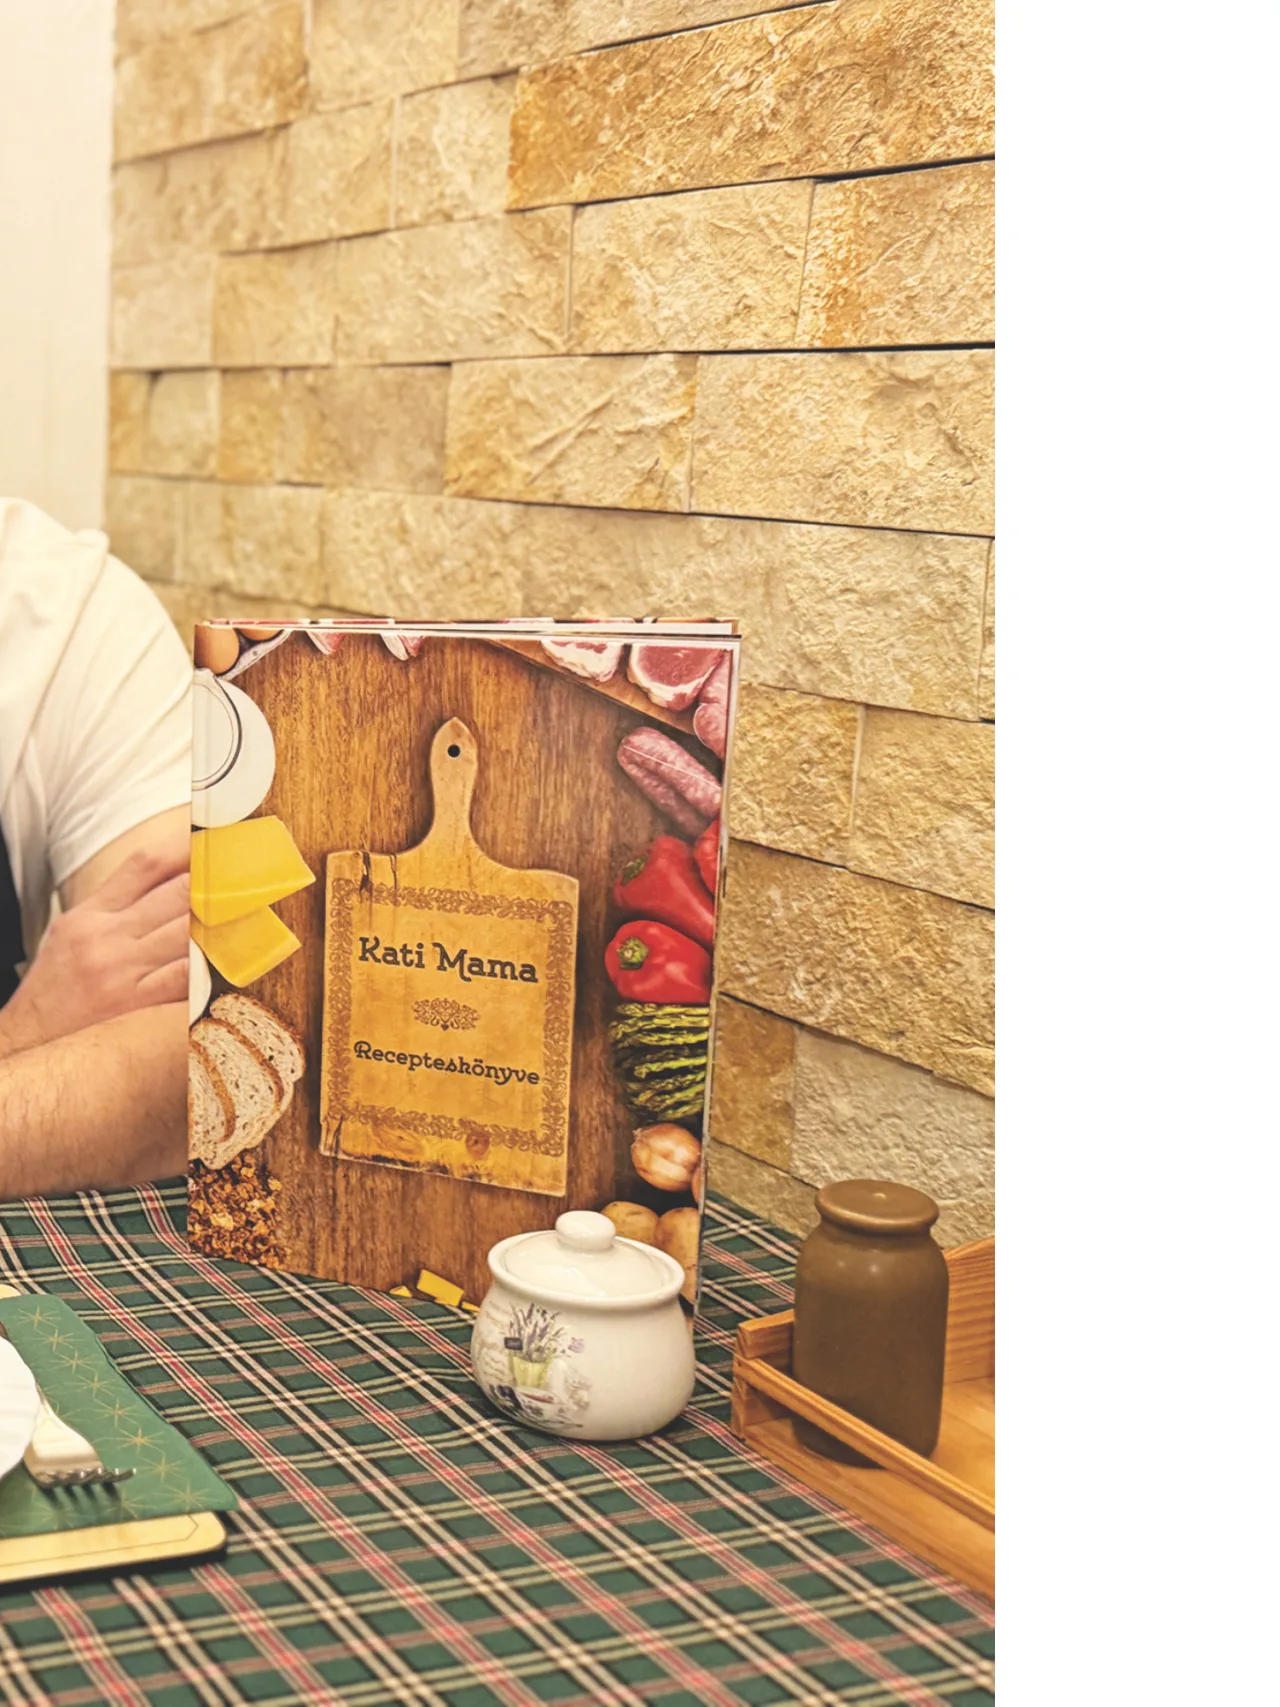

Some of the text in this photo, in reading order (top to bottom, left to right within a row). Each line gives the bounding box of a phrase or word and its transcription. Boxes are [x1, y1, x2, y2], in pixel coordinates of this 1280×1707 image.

[358, 936, 538, 983] Kati Mama
[353, 1041, 540, 1086] Recepteskönyve
